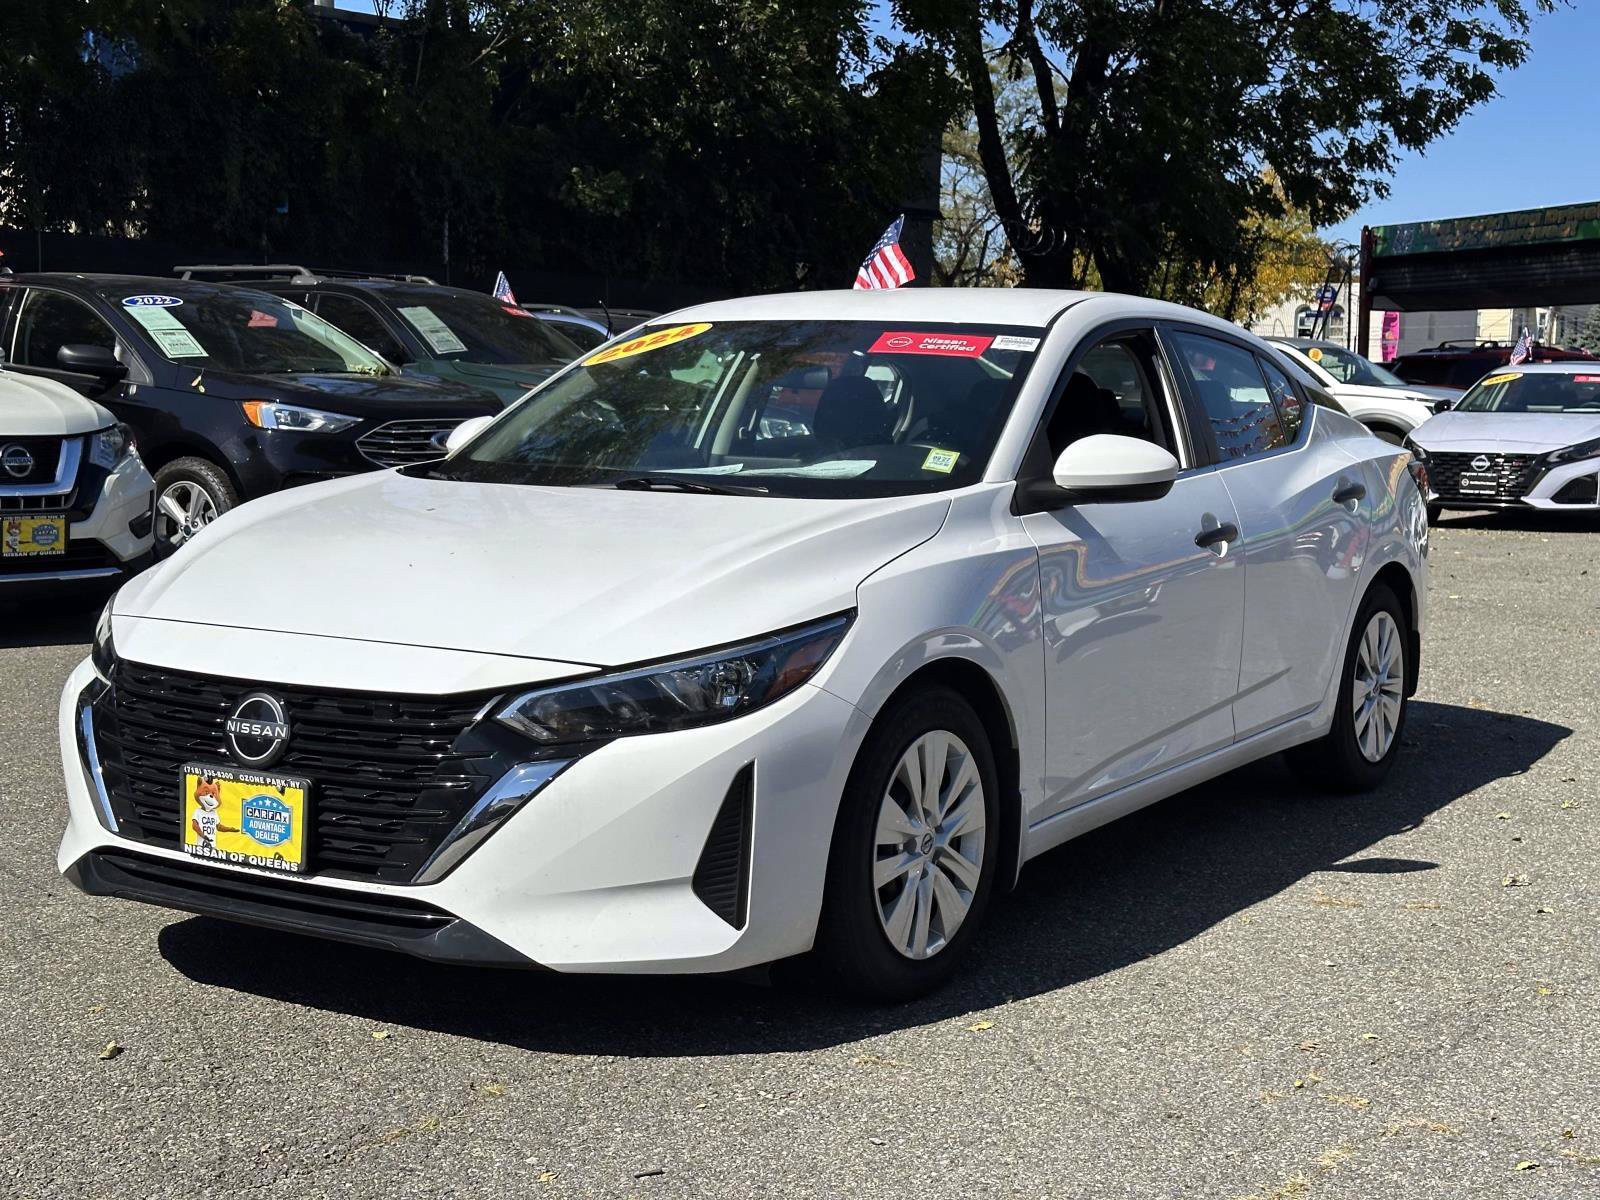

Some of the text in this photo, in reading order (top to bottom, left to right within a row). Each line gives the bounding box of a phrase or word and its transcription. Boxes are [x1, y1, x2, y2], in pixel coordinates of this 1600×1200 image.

[134, 297, 172, 305] 2022
[597, 327, 694, 362] 2024
[918, 343, 976, 352] Certified
[923, 337, 967, 345] Nissan
[227, 720, 288, 738] NISSAN
[184, 766, 201, 775] (718)
[240, 774, 264, 784] OZONE
[290, 780, 300, 789] NY
[202, 816, 215, 825] CAR
[247, 807, 288, 823] CARFAX
[203, 826, 215, 835] FOX
[249, 820, 286, 834] ADVANTAGE
[255, 830, 280, 843] DEALER
[184, 844, 298, 871] NISSAN OF QUEENS
